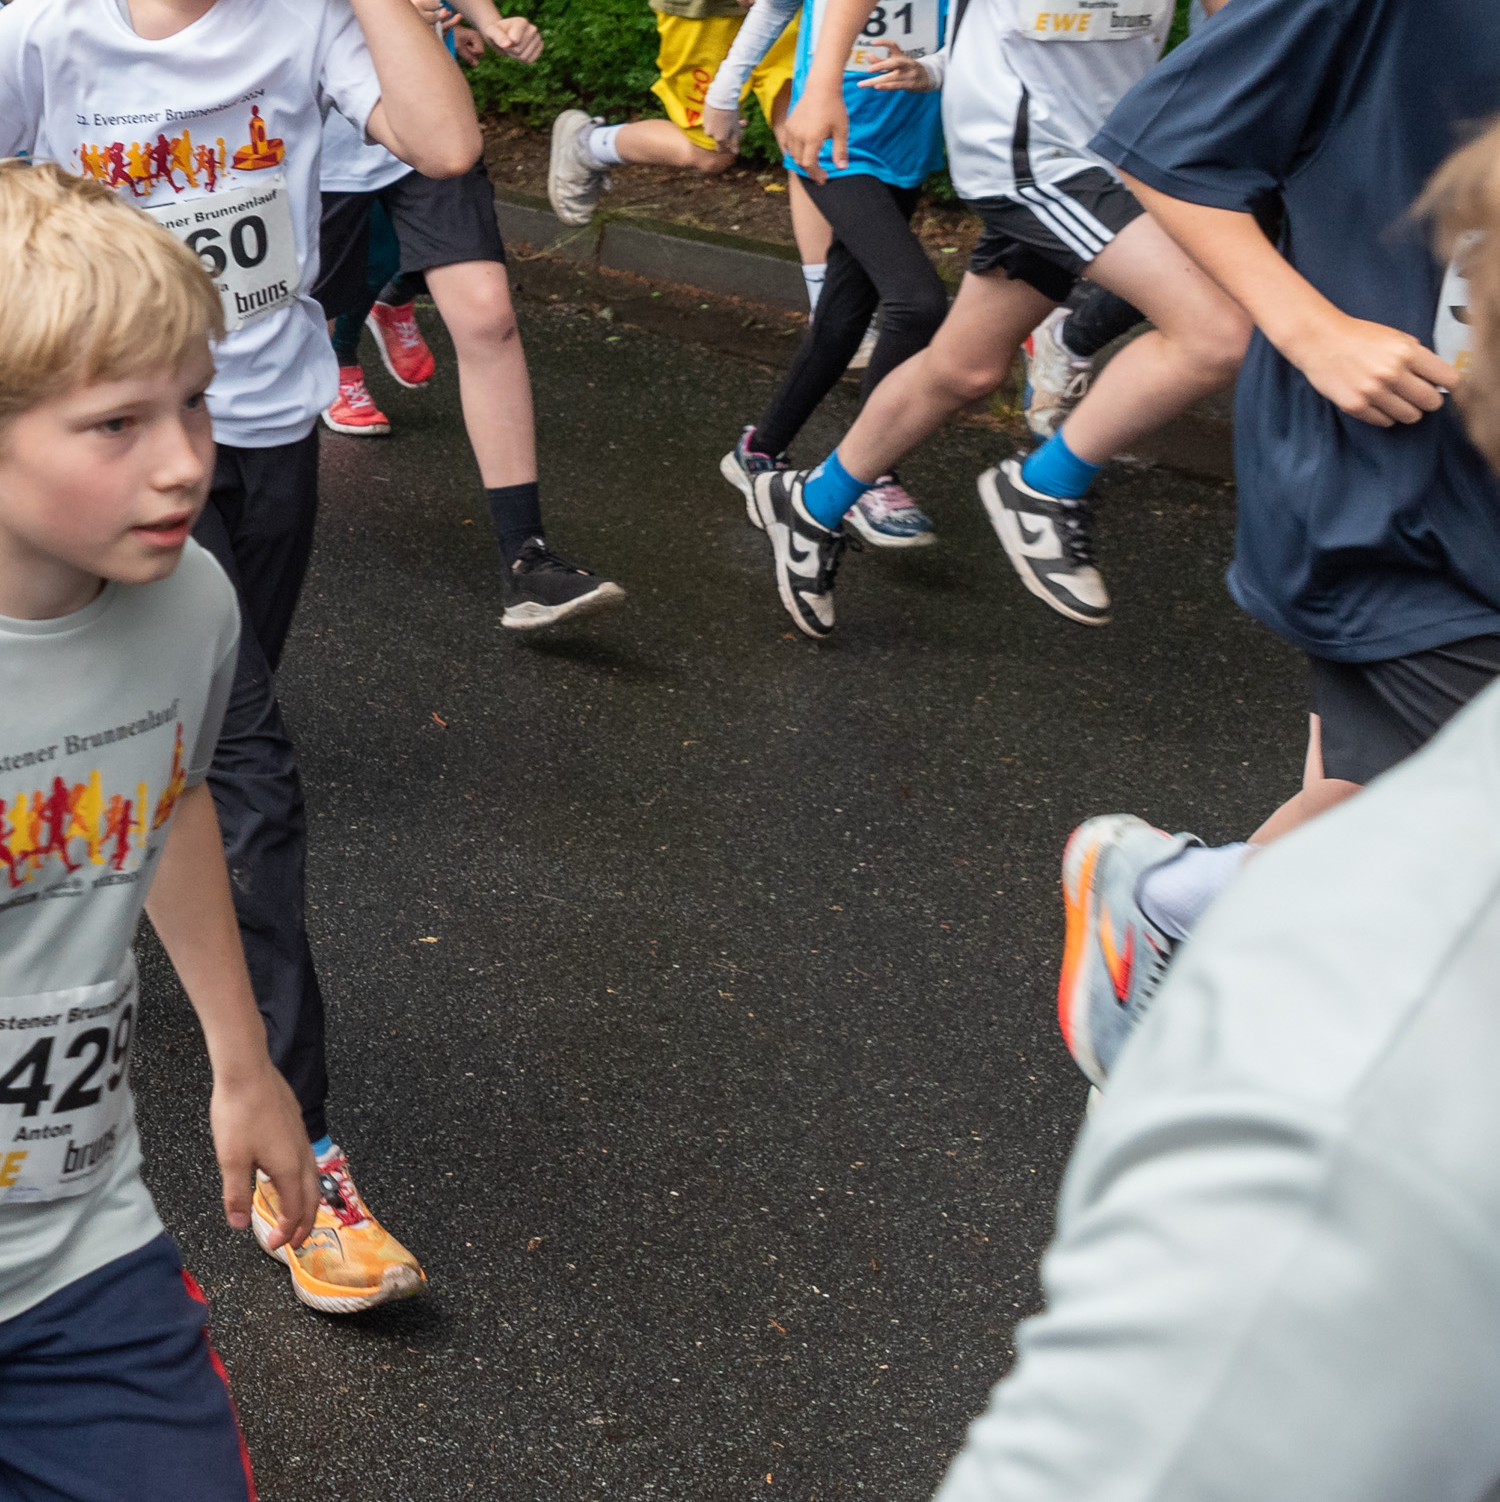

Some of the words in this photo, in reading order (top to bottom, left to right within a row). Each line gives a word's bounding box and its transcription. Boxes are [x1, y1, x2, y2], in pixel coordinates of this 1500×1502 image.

[862, 2, 914, 37] 81
[1034, 12, 1092, 32] EWE
[93, 111, 161, 126] Everstener
[194, 189, 278, 223] Brunnenlauf
[184, 215, 269, 278] 60
[235, 280, 289, 314] bruns
[12, 1123, 74, 1143] Anton
